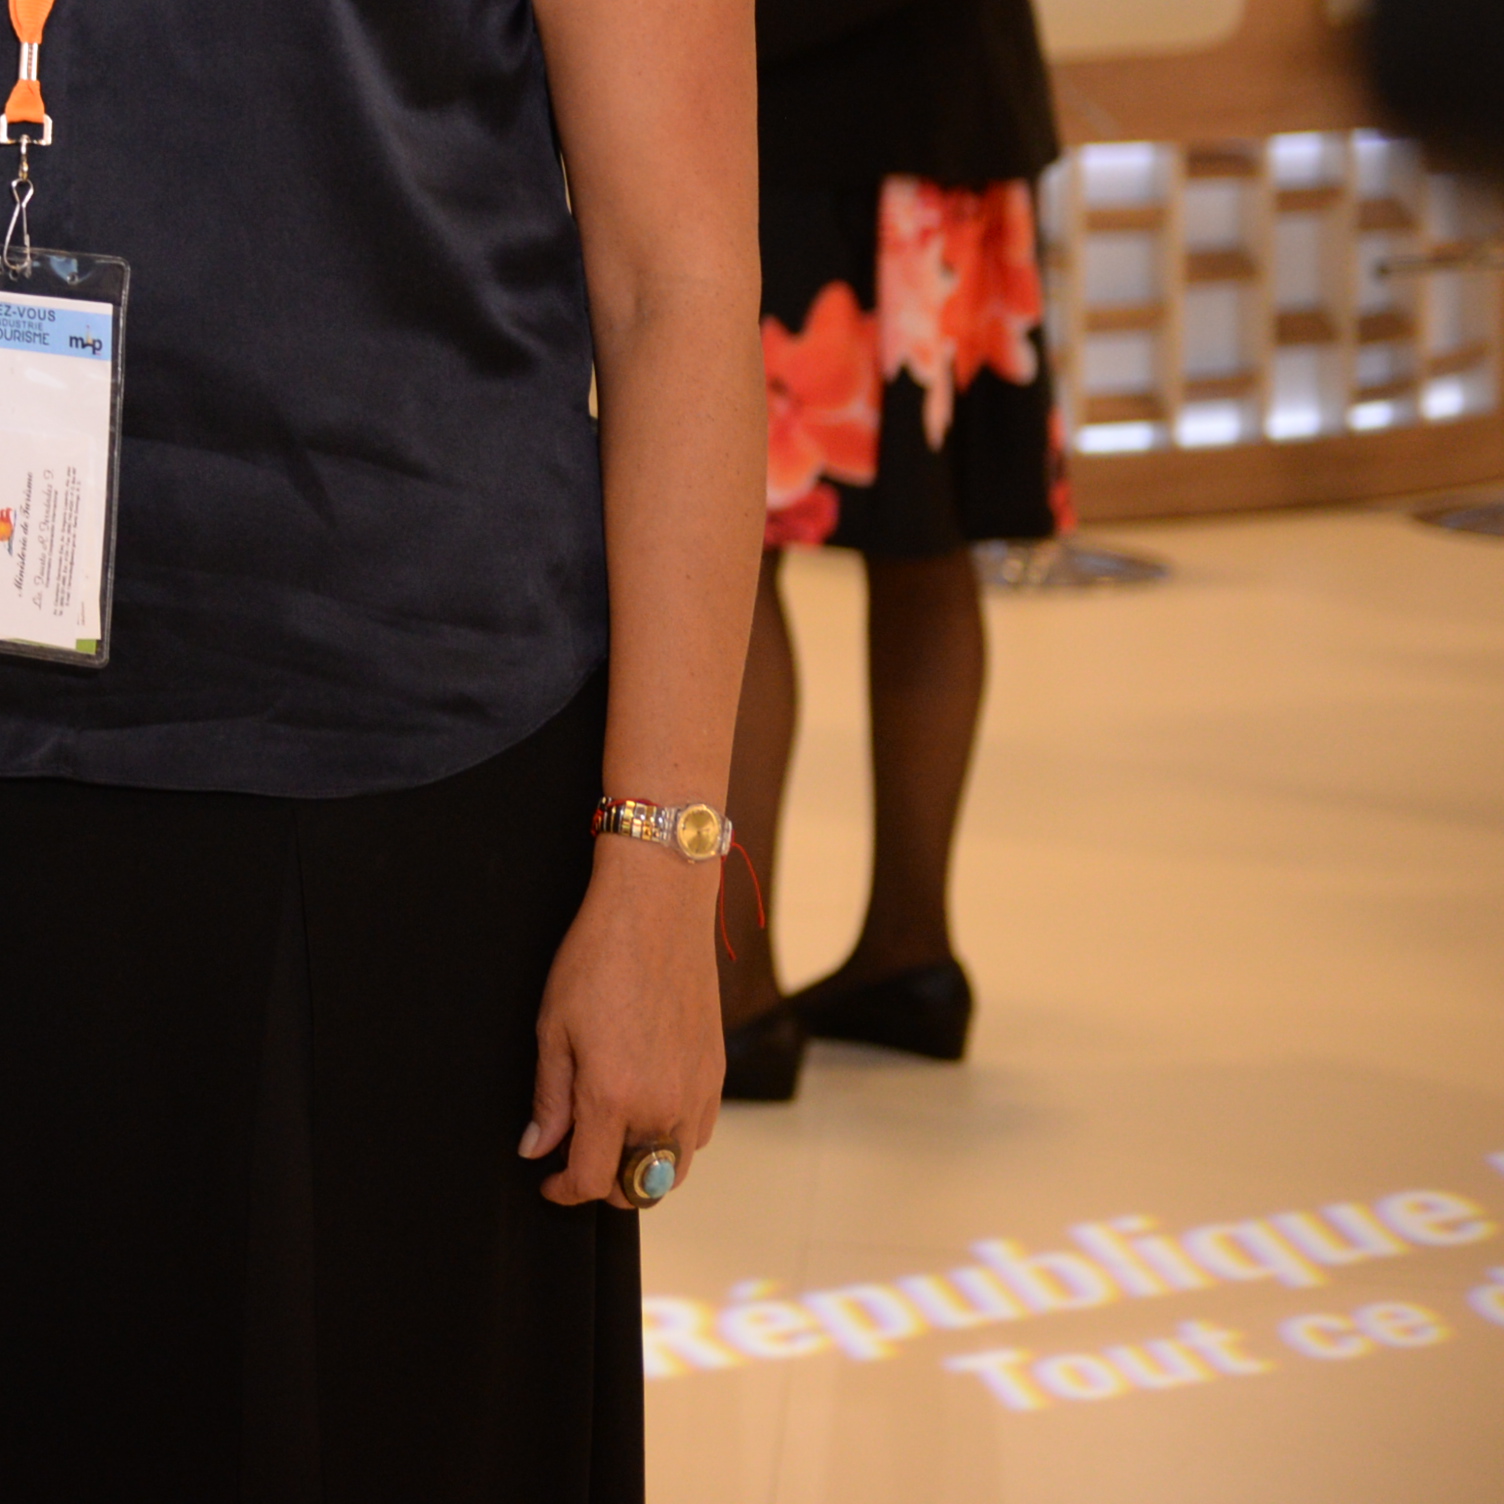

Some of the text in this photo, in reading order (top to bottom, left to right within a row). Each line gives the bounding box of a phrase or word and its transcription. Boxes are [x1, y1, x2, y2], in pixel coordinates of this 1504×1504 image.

[14, 537, 28, 598] Ministerio
[20, 521, 29, 535] de
[642, 1188, 1498, 1379] République
[944, 1299, 1454, 1412] Tout ce
